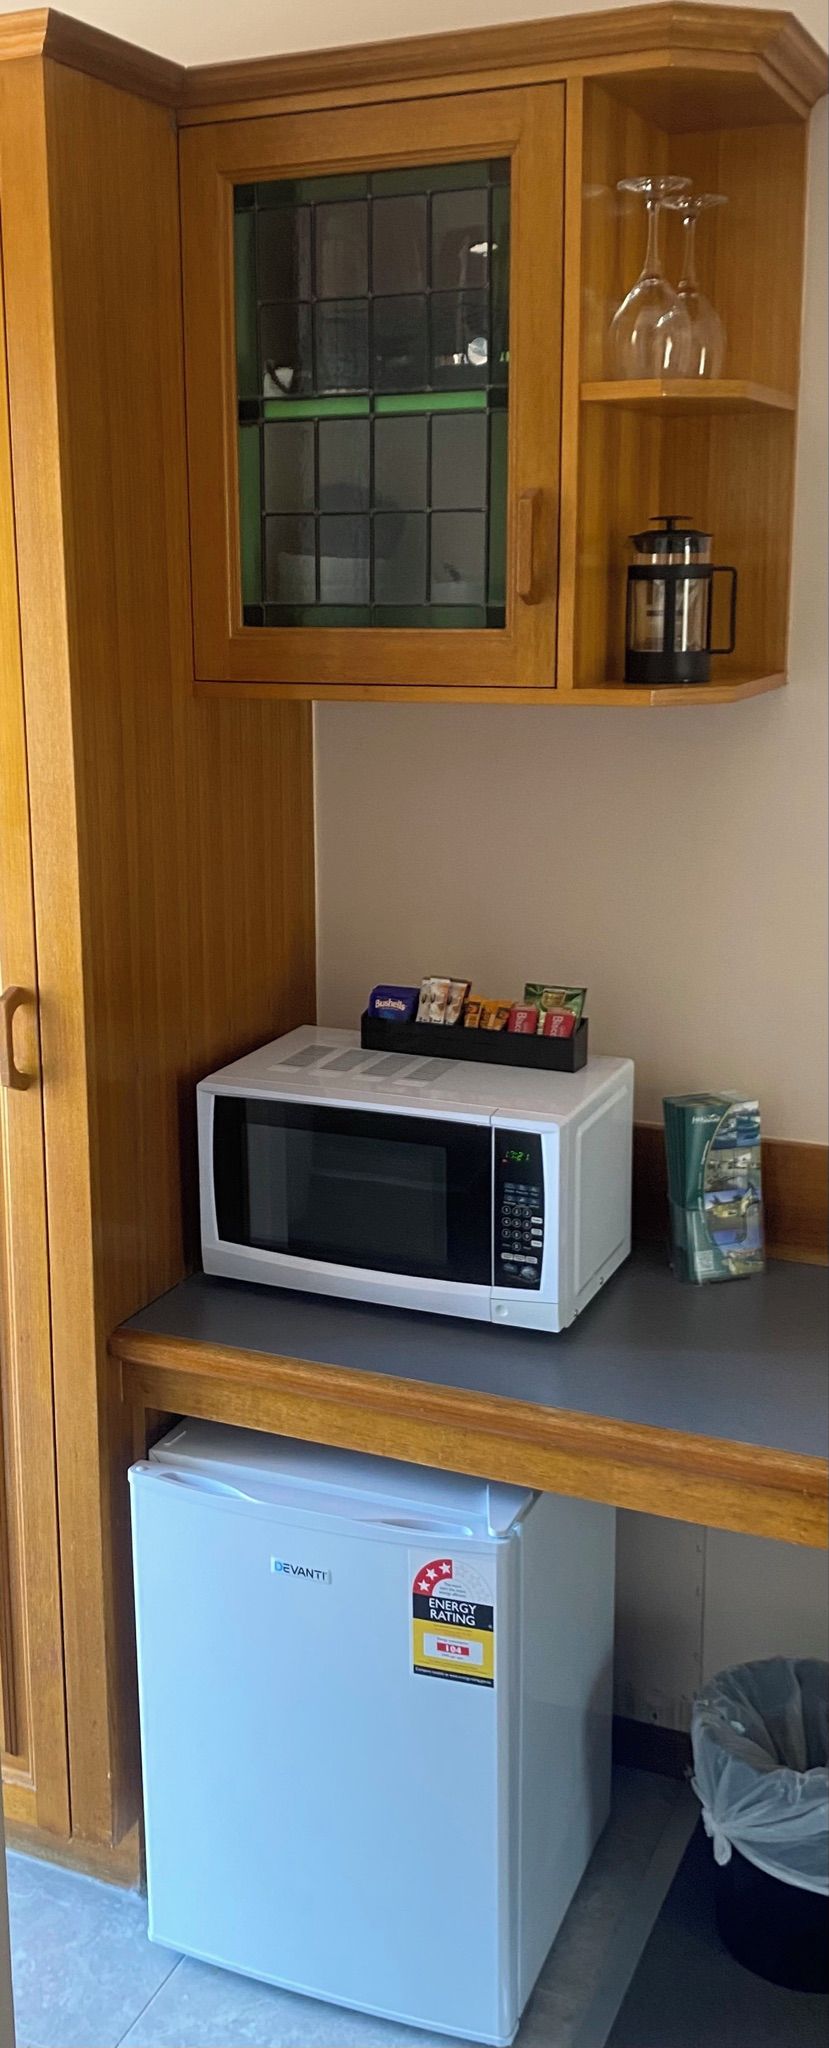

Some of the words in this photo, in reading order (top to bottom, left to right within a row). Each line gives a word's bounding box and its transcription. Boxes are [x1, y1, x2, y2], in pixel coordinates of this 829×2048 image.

[375, 998, 407, 1011] Bushells
[274, 1560, 325, 1581] DEVANTI
[428, 1597, 477, 1615] ENERGY
[430, 1609, 476, 1626] RATING
[445, 1643, 462, 1655] 104
